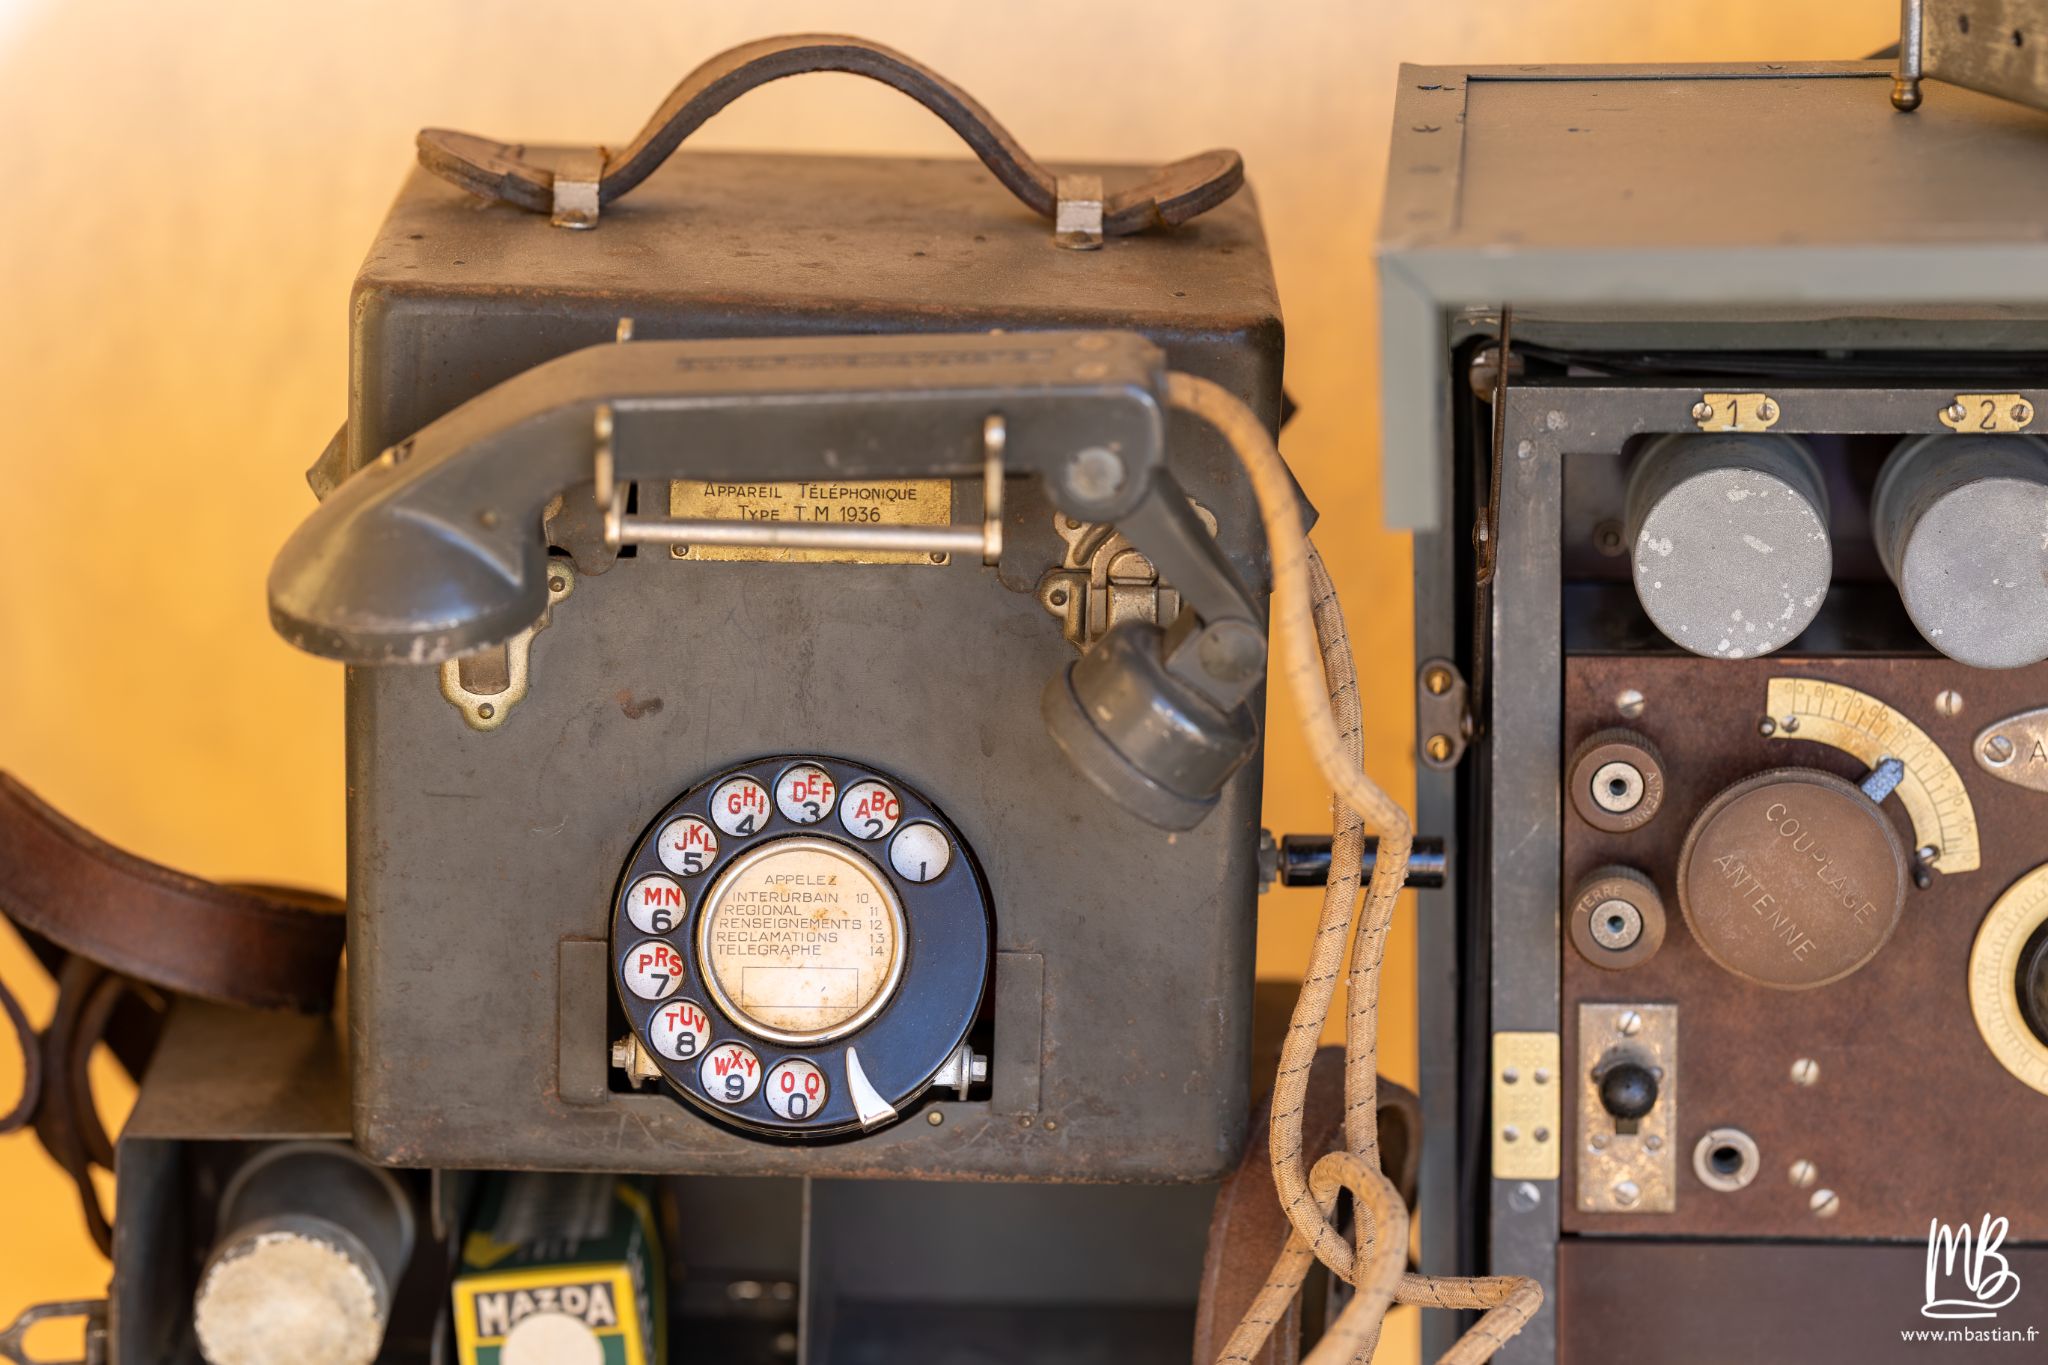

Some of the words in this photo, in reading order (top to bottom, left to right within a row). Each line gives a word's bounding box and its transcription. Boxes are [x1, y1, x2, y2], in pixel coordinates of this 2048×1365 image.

[1726, 399, 1738, 428] 1
[1980, 399, 1997, 430] 2
[704, 481, 783, 499] APPAREIL
[798, 482, 918, 503] TÉLÉPHONIQUE
[738, 504, 780, 522] TYPE
[840, 506, 881, 523] 1936
[727, 786, 765, 815] GHI
[792, 774, 834, 803] DEF
[800, 801, 821, 824] 3
[855, 791, 899, 821] ABC
[735, 814, 755, 835] 4
[866, 819, 885, 840] 2
[674, 824, 717, 853] JKL
[682, 852, 703, 876] 5
[919, 861, 927, 882] 1
[1766, 803, 1877, 925] COUPLAGE
[765, 874, 837, 886] APPELEZ
[643, 887, 681, 907] MN
[733, 891, 839, 903] INTERURBAIN
[856, 893, 869, 904] 10
[1576, 885, 1623, 913] TERRE
[1713, 854, 1817, 962] ANTENNE
[651, 909, 672, 933] 6
[724, 904, 803, 916] REGIONAL
[870, 906, 879, 917] 11
[719, 918, 862, 930] RENSEIGNEMENTS
[869, 919, 883, 931] 12
[716, 931, 838, 943] RECLAMATIONS
[870, 933, 885, 944] 13
[638, 946, 683, 978] PRS
[718, 944, 822, 956] TELEGRAPHE
[870, 945, 885, 957] 14
[650, 973, 670, 998] 7
[665, 1006, 706, 1034] TUV
[675, 1031, 697, 1057] 8
[714, 1049, 758, 1078] WXY
[724, 1074, 745, 1100] 9
[787, 1092, 808, 1119] 0
[477, 1282, 617, 1337] MAZDA
